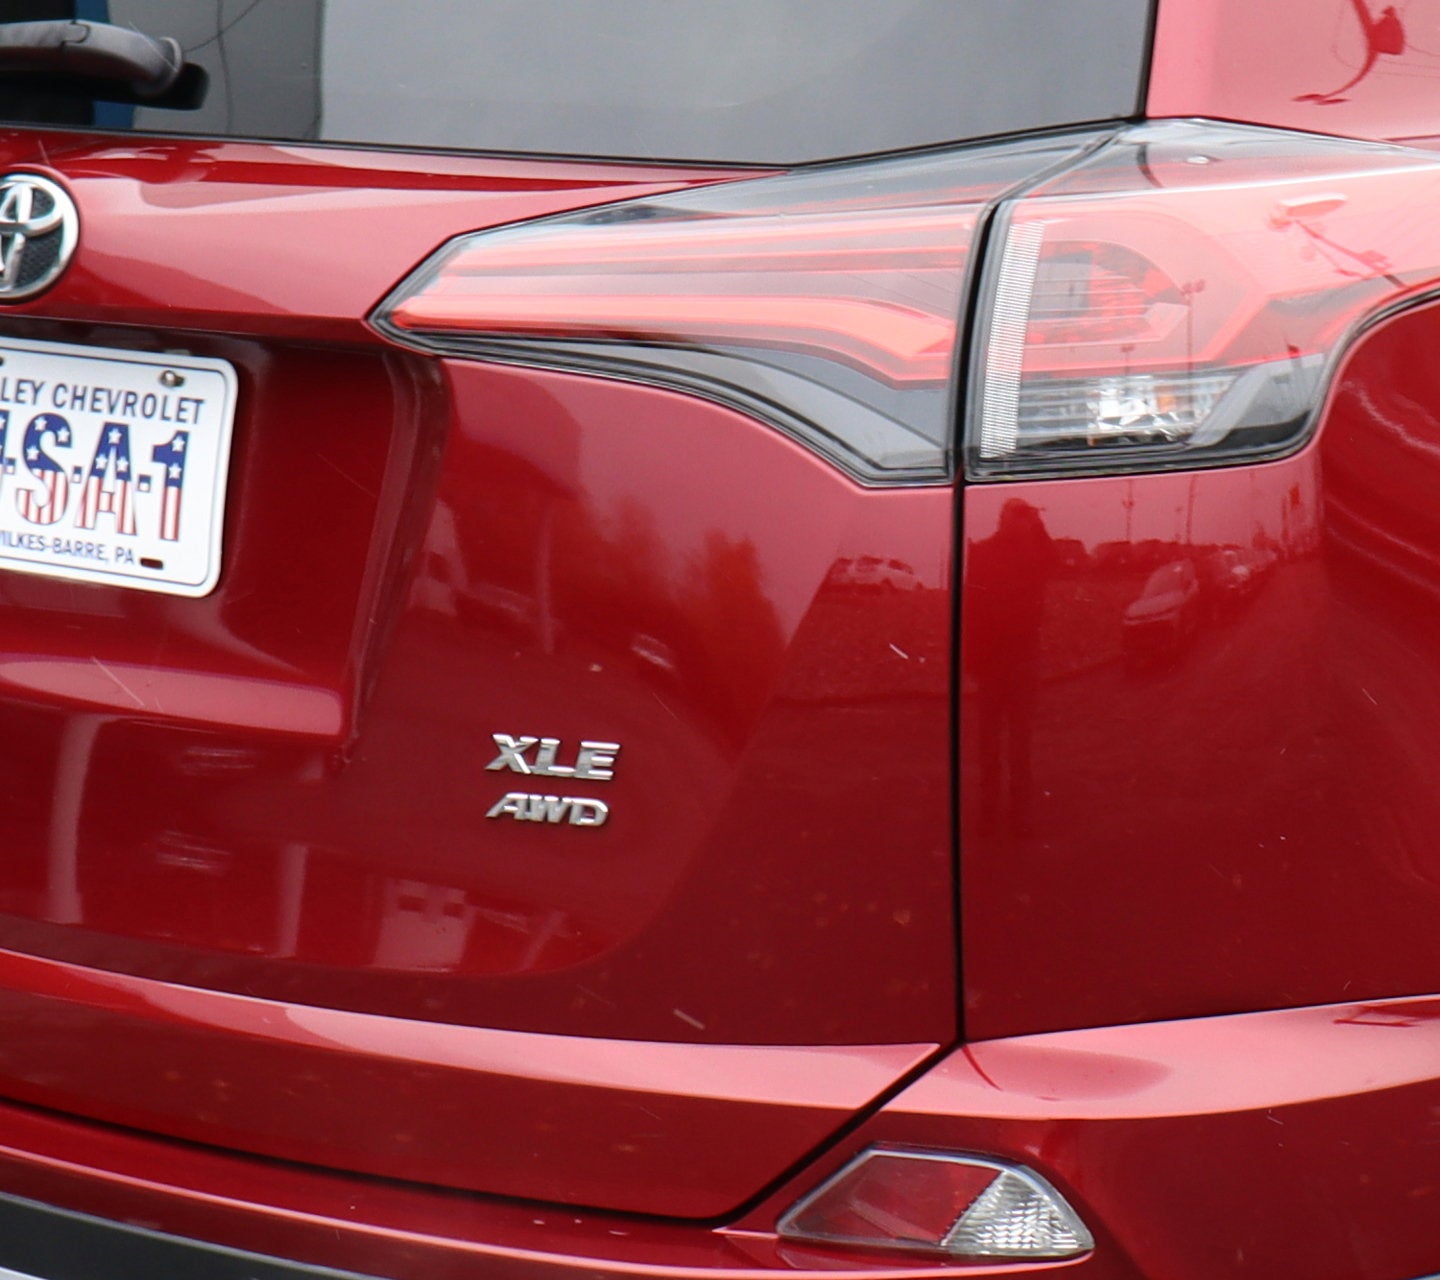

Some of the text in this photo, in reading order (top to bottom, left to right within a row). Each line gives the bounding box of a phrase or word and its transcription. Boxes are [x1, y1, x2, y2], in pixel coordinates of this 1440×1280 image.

[52, 383, 205, 424] CHEVROLET
[115, 546, 135, 564] PA
[484, 733, 621, 781] XLE
[485, 792, 609, 827] AWD
